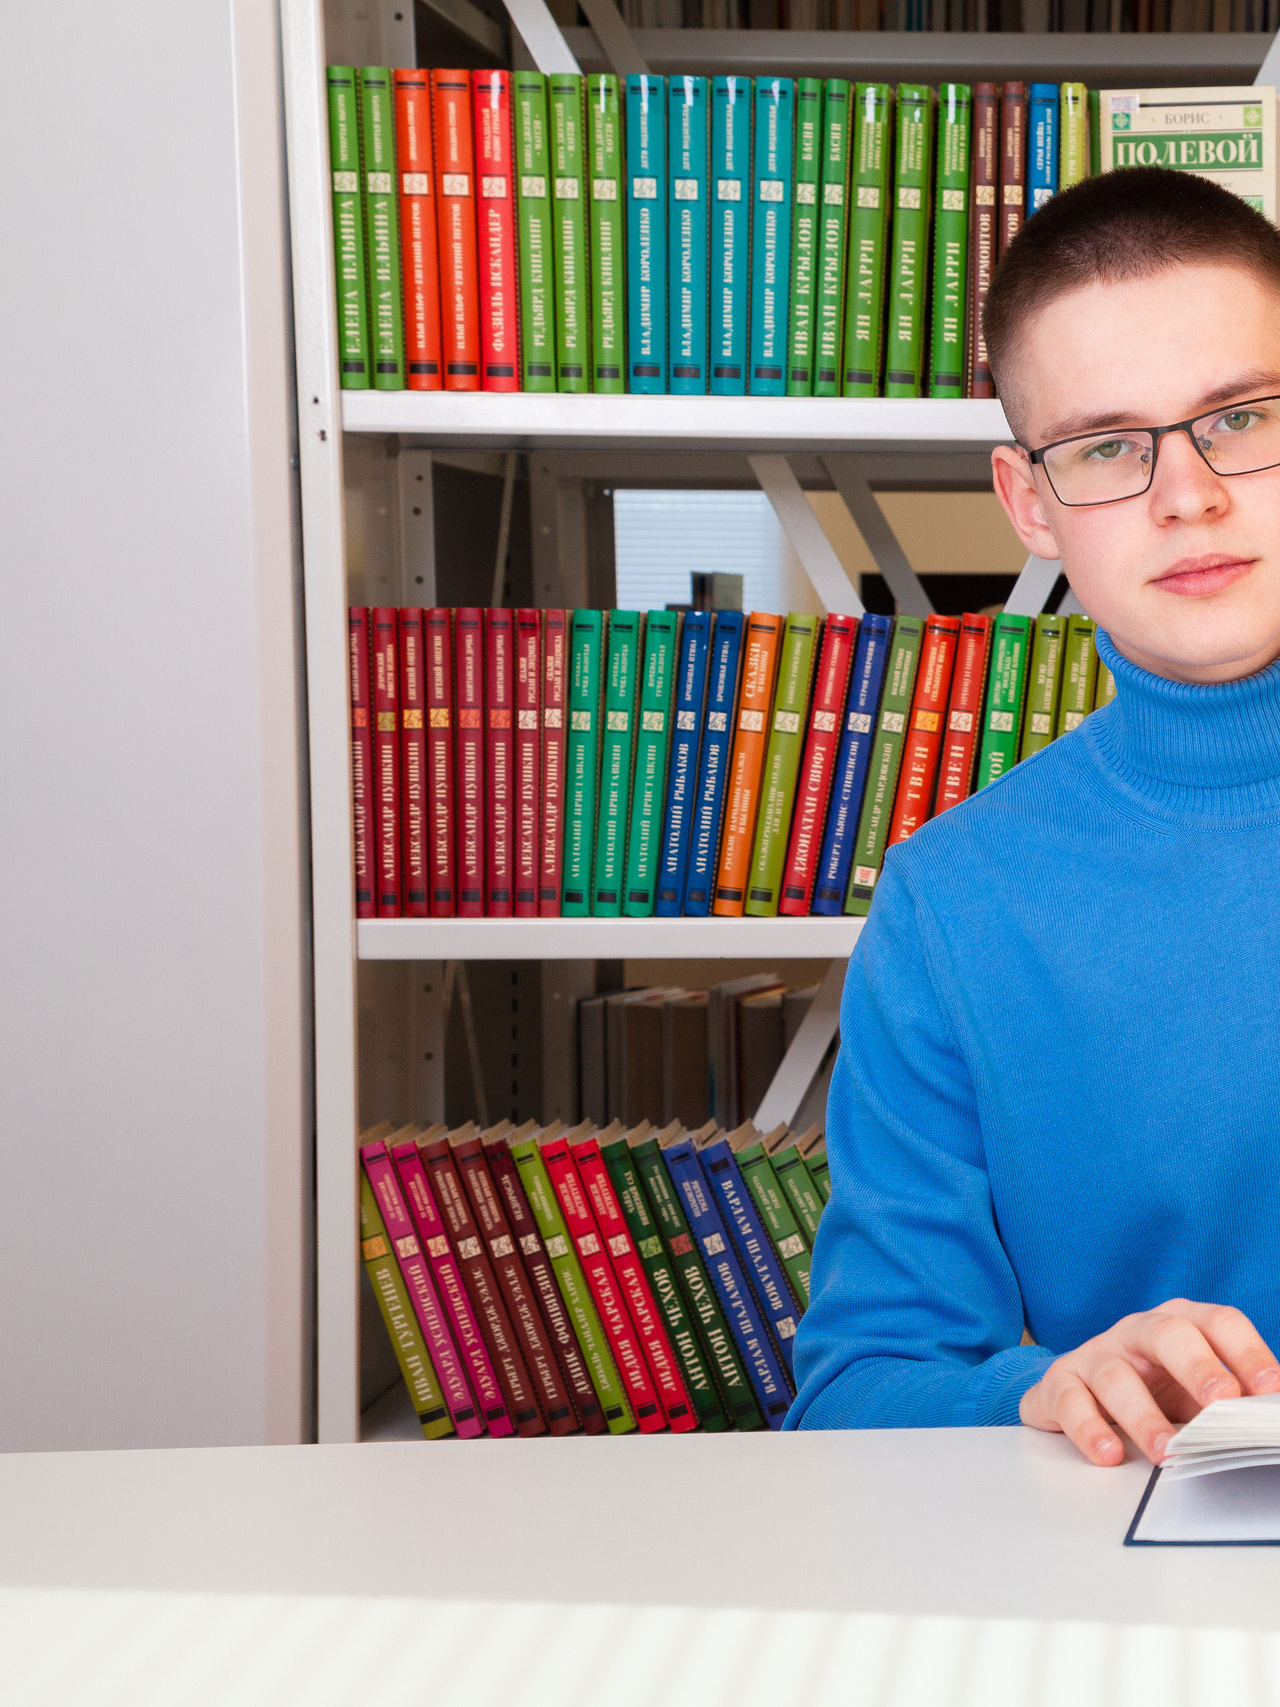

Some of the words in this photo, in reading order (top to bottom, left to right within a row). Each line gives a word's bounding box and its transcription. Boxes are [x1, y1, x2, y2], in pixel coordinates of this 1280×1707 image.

[802, 122, 814, 160] БАСНИ
[830, 123, 842, 161] БАСНИ
[1035, 122, 1044, 146] ШЕЙКА
[1164, 112, 1210, 125] БОРИС
[1116, 134, 1259, 166] ПОЛЕВОЙ
[340, 200, 357, 280] ИЛЬИНА
[374, 201, 391, 280] ИЛЬИНА
[412, 203, 421, 239] ПЕТРОВ
[489, 209, 502, 286] ИСКАНДЕР
[529, 215, 543, 283] КИПЛИНГ
[640, 208, 650, 281] КОРОЛЕНКО
[681, 209, 691, 283] КОРОЛЕНКО
[723, 210, 734, 283] КОРОЛЕНКО
[765, 211, 776, 284] КОРОЛЕНКО
[562, 217, 575, 284] КИПЛИНГ
[600, 217, 612, 286] КИПЛИНГ
[797, 218, 811, 294] КРЫЛОВ
[824, 219, 839, 295] КРЫЛОВ
[858, 239, 874, 304] ЛАРРИ
[900, 240, 915, 305] ЛАРРИ
[945, 242, 959, 306] ЛАРРИ
[342, 290, 360, 353] ЕЛЕНА
[376, 291, 394, 354] ЕЛЕНА
[492, 292, 505, 351] ФАЗИЛЬ
[532, 288, 545, 346] РЕДЬЯРД
[564, 290, 578, 347] РЕДЬЯРД
[602, 291, 615, 348] РЕДЬЯРД
[640, 286, 651, 355] ВЛАДИМИР
[682, 287, 692, 356] ВЛАДИМИР
[723, 288, 733, 356] ВЛАДИМИР
[764, 288, 775, 357] ВЛАДИМИР
[795, 304, 809, 355] ИВАН
[822, 305, 835, 356] ИВАН
[857, 315, 870, 341] ЯН
[898, 315, 912, 341] ЯН
[944, 317, 957, 343] ЯН
[744, 643, 761, 697] СКАЗКИ
[352, 741, 364, 798] ПУШКИН
[382, 745, 393, 802] ПУШКИН
[408, 743, 420, 799] ПУШКИН
[435, 742, 447, 797] ПУШКИН
[464, 742, 476, 798] ПУШКИН
[494, 743, 506, 799] ПУШКИН
[522, 743, 533, 800] ПУШКИН
[546, 741, 558, 797] ПУШКИН
[574, 745, 584, 815] ПРИСТАВКИН
[608, 745, 621, 815] ПРИСТАВКИН
[642, 745, 656, 815] ПРИСТАВКИН
[673, 743, 689, 800] РЫБАКОВ
[704, 744, 720, 801] РЫБАКОВ
[840, 741, 860, 800] СТИВЕНСОН
[874, 743, 893, 803] ТВАРДОВСКИЙ
[906, 746, 929, 799] ТВЕН
[944, 745, 964, 800] ТВЕН
[436, 802, 449, 876] АЛЕКСАНДР
[545, 802, 558, 875] АЛЕКСАНДР
[793, 797, 817, 877] ДЖОНАТАН
[808, 744, 826, 791] СВИФТ
[835, 804, 848, 840] ЛЬЮИС
[867, 805, 882, 856] АЛЕКСАНДР
[353, 803, 366, 877] АЛЕКСАНДР
[383, 806, 395, 881] АЛЕКСАНДР
[409, 804, 422, 878] АЛЕКСАНДР
[464, 803, 477, 877] АЛЕКСАНДР
[494, 803, 508, 877] АЛЕКСАНДР
[521, 804, 534, 878] АЛЕКСАНДР
[572, 820, 582, 878] АНАТОЛИЙ
[605, 820, 617, 878] АНАТОЛИЙ
[638, 821, 650, 878] АНАТОЛИЙ
[666, 806, 683, 874] АНАТОЛИЙ
[696, 806, 713, 875] АНАТОЛИЙ
[827, 844, 841, 879] РОБЕРТ
[501, 1175, 524, 1221] НЕДОРОСЛЬ
[721, 1180, 748, 1233] ВАРЛАМ
[746, 1238, 783, 1310] ШАЛАМОВ
[375, 1267, 414, 1350] ТУРГЕНЕВ
[408, 1265, 447, 1346] УСПЕНСКИЙ
[439, 1264, 478, 1345] УСПЕНСКИЙ
[471, 1266, 493, 1303] УЭЛЛС
[504, 1265, 526, 1301] УЭЛЛС
[533, 1264, 570, 1344] ФОНВИЗИН
[592, 1266, 626, 1334] ЧАРСКАЯ
[623, 1267, 656, 1335] ЧАРСКАЯ
[653, 1268, 684, 1326] ЧЕХОВ
[684, 1266, 715, 1323] ЧЕХОВ
[717, 1262, 754, 1334] ШАЛАМОВ
[484, 1305, 509, 1351] ДЖОРДЖ
[517, 1304, 543, 1350] ДЖОРДЖ
[406, 1355, 433, 1402] ИВАН
[440, 1350, 465, 1400] ЭДУАРД
[471, 1349, 496, 1400] ЭДУАРД
[501, 1357, 525, 1401] ГЕРБЕРТ
[534, 1355, 558, 1400] ГЕРБЕРТ
[564, 1348, 589, 1395] ДЕНИС
[622, 1340, 646, 1391] ЛИДИЯ
[650, 1340, 676, 1391] ЛИДИЯ
[680, 1331, 709, 1390] АНТОН
[711, 1328, 743, 1387] АНТОН
[747, 1339, 776, 1394] ВАРЛАМ
